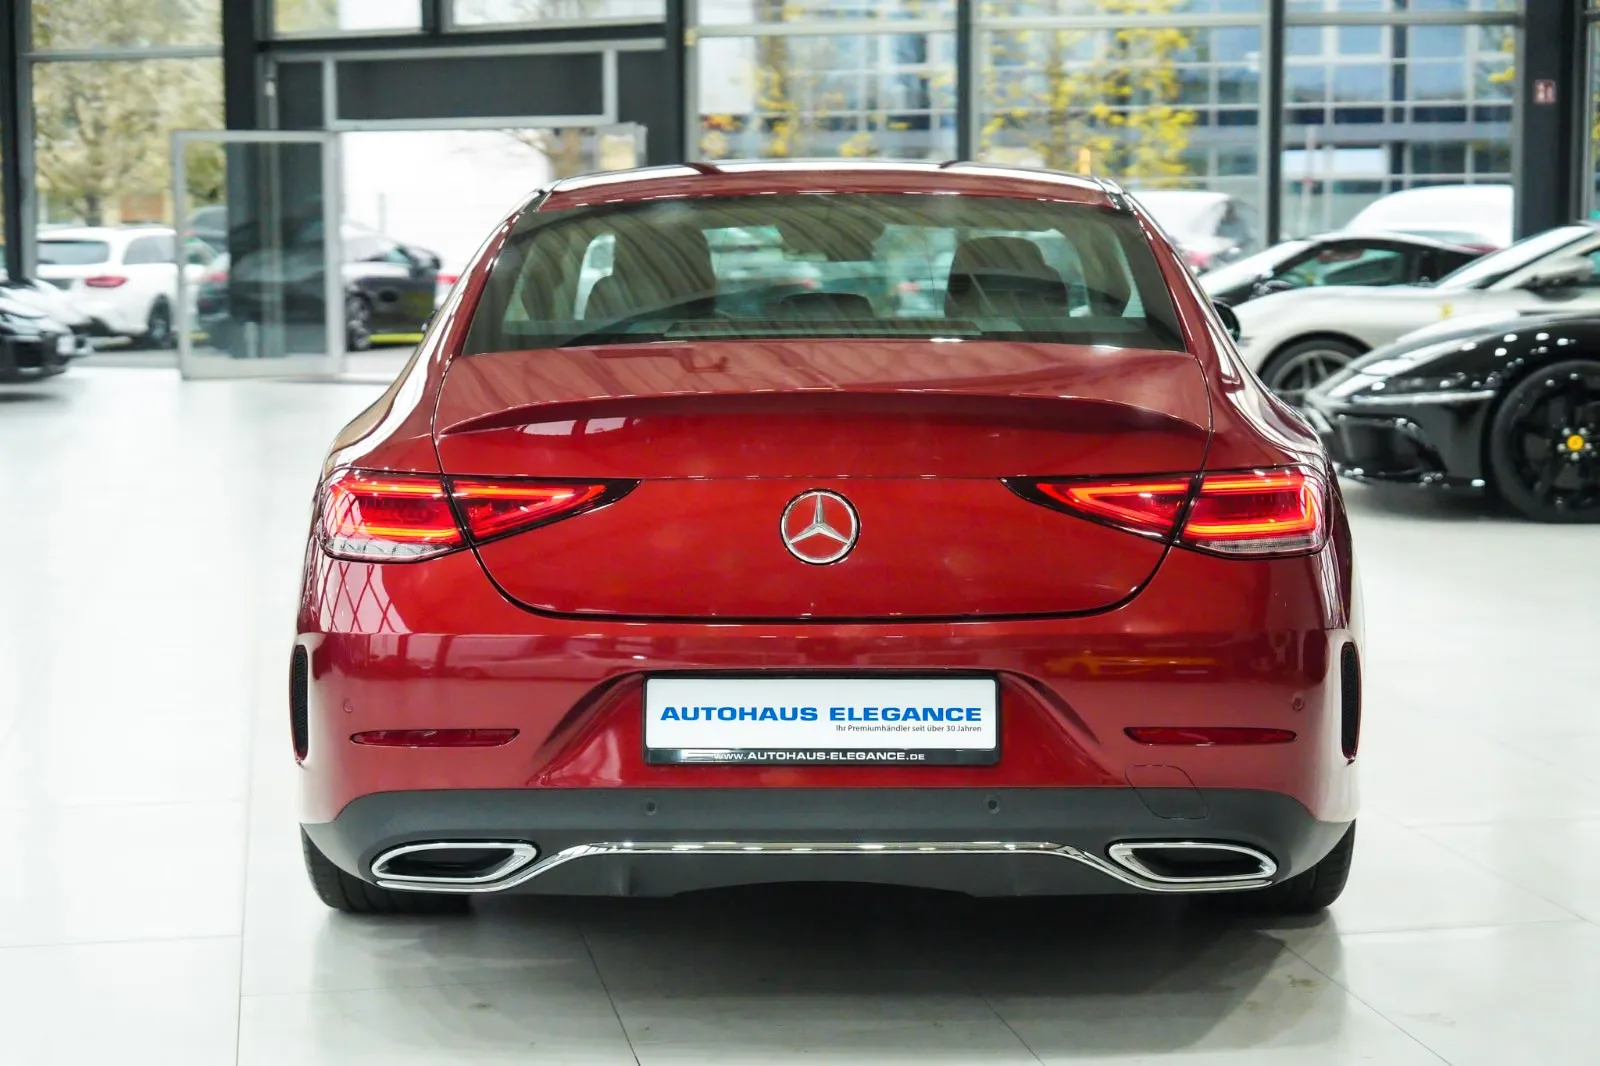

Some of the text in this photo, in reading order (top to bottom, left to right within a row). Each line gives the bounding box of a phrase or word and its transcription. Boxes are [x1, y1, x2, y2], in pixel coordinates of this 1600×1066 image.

[660, 706, 982, 721] AUTOHAUS ELEGANCE
[835, 724, 982, 732] Ihr Premiumhändler seit über 30 Jahren
